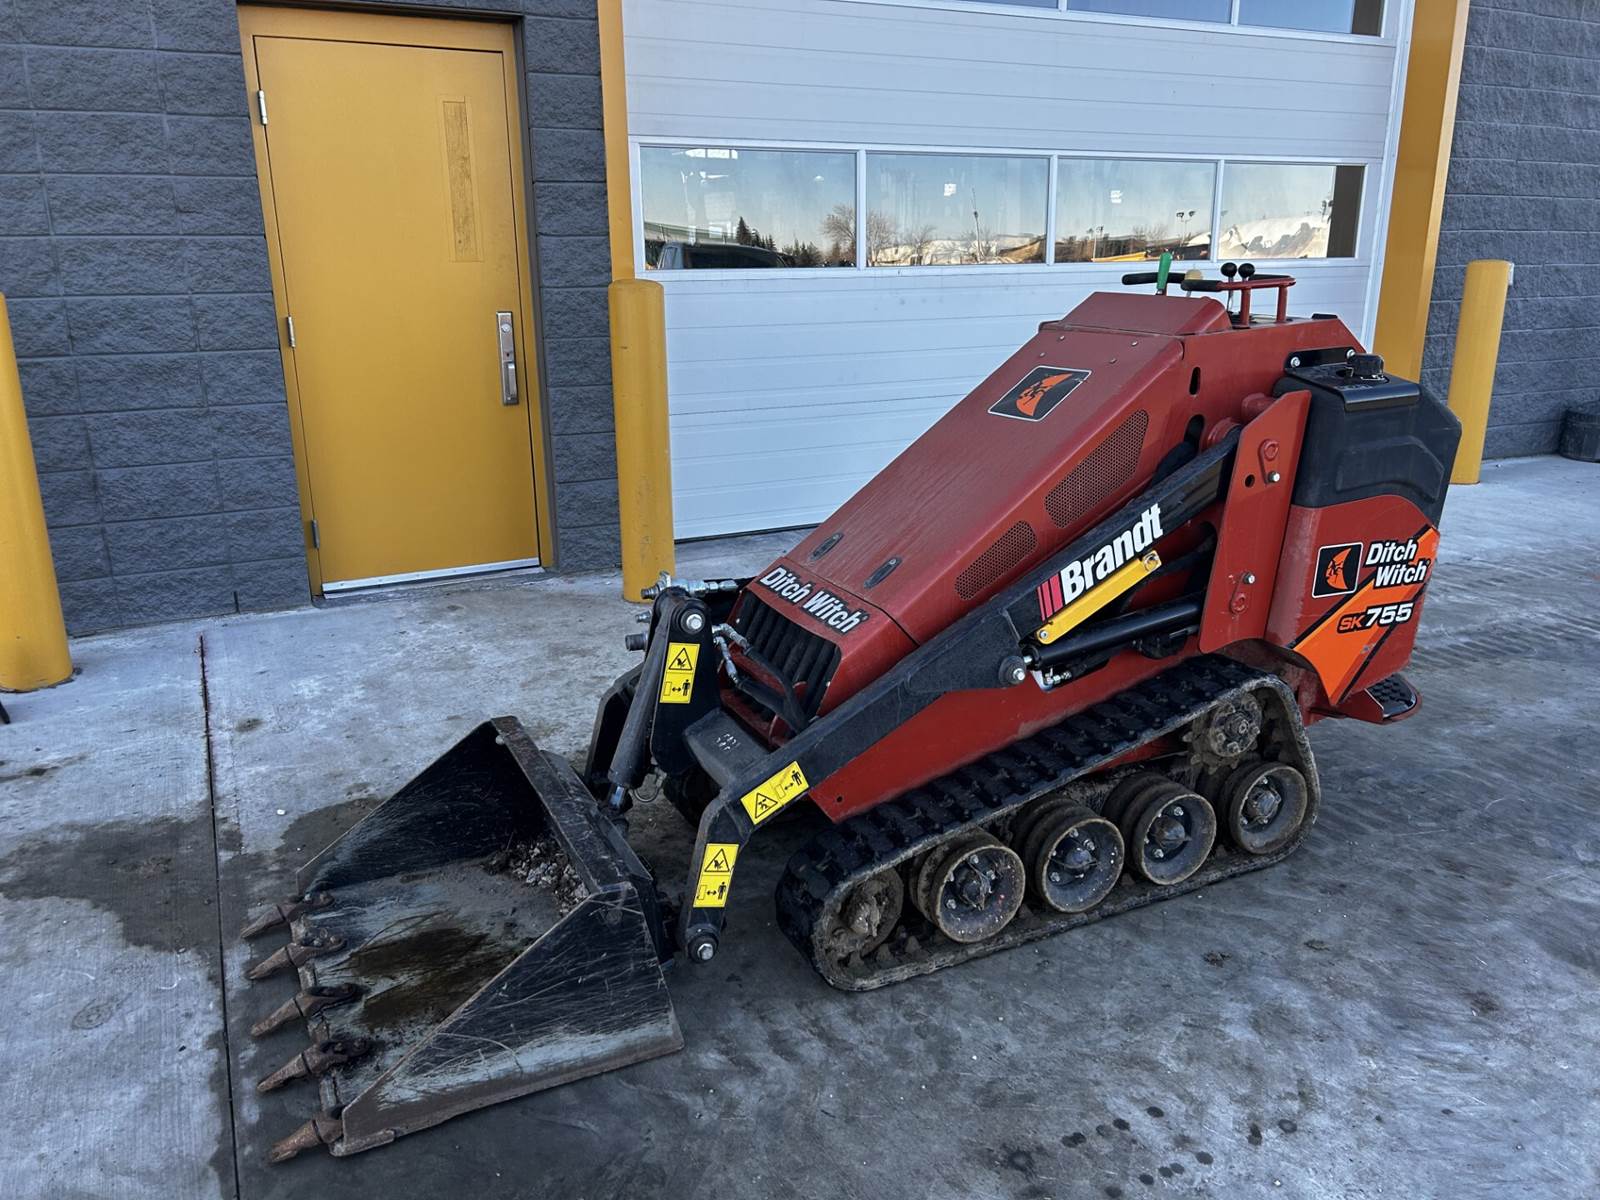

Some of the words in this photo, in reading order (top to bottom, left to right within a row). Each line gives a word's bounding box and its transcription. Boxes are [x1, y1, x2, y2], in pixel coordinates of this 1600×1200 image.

[1060, 502, 1164, 605] Brandt
[1365, 538, 1417, 566] Ditch
[1375, 560, 1429, 587] Witch
[760, 567, 812, 603] Ditch
[803, 590, 863, 633] Witch
